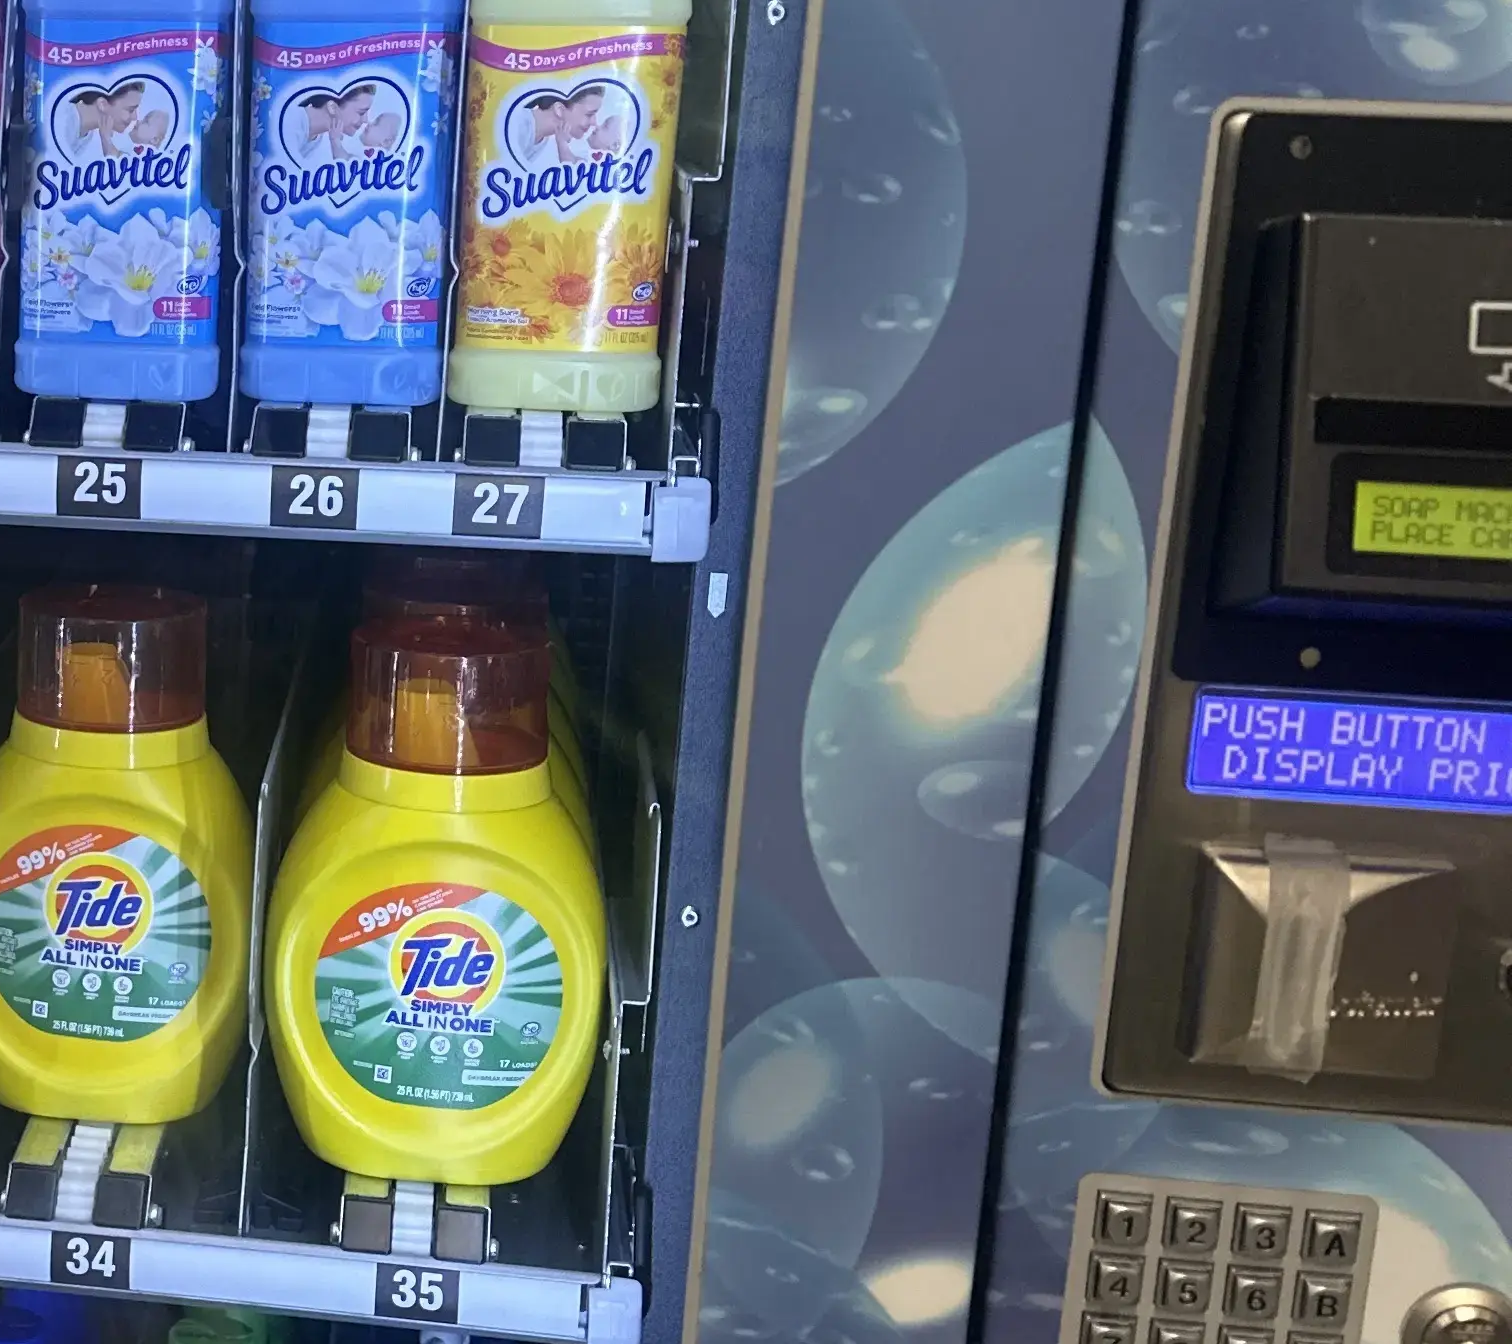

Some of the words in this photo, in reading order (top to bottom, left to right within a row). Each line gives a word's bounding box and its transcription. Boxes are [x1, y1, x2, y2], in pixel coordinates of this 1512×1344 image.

[48, 46, 73, 64] 45
[76, 47, 105, 62] Days
[108, 43, 121, 56] of
[123, 36, 188, 53] Freshness
[277, 49, 302, 67] 45
[305, 50, 336, 65] Days
[339, 46, 353, 59] of
[355, 38, 422, 56] Freshness
[504, 53, 531, 70] 45
[533, 54, 566, 68] Days
[568, 48, 583, 62] of
[585, 40, 653, 57] Freshness
[33, 143, 192, 210] Suavitel
[261, 146, 424, 215] Suavitel
[482, 148, 653, 218] Suavitel
[74, 462, 127, 504] 25
[289, 474, 344, 517] 26
[473, 482, 528, 526] 27
[1372, 495, 1440, 519] SOAP
[1455, 500, 1512, 524] MAC
[1370, 520, 1455, 546] PLACE
[1202, 703, 1306, 743] PUSH
[1330, 711, 1487, 755] BUTTON
[1222, 745, 1404, 790] DISPLAY
[1428, 758, 1512, 797] PRI
[16, 841, 66, 875] 99%
[55, 879, 143, 936] Tide
[358, 898, 413, 933] 99%
[41, 948, 77, 966] ALL
[79, 953, 100, 967] IN
[100, 957, 141, 972] ONE
[64, 938, 122, 956] SIMPLY
[401, 936, 495, 997] Tide
[148, 996, 159, 1006] 17
[410, 999, 474, 1016] SIMPLY
[385, 1009, 424, 1028] ALL
[427, 1015, 448, 1030] IN
[449, 1019, 492, 1034] ONE
[499, 1059, 510, 1068] 17
[1122, 1216, 1134, 1239] 1
[1187, 1220, 1208, 1244] 2
[1256, 1227, 1276, 1251] 3
[66, 1237, 116, 1278] 34
[1323, 1233, 1348, 1258] A
[391, 1269, 443, 1312] 35
[1108, 1275, 1130, 1299] 4
[1178, 1282, 1198, 1305] 5
[1247, 1288, 1267, 1312] 6
[1316, 1294, 1339, 1319] B
